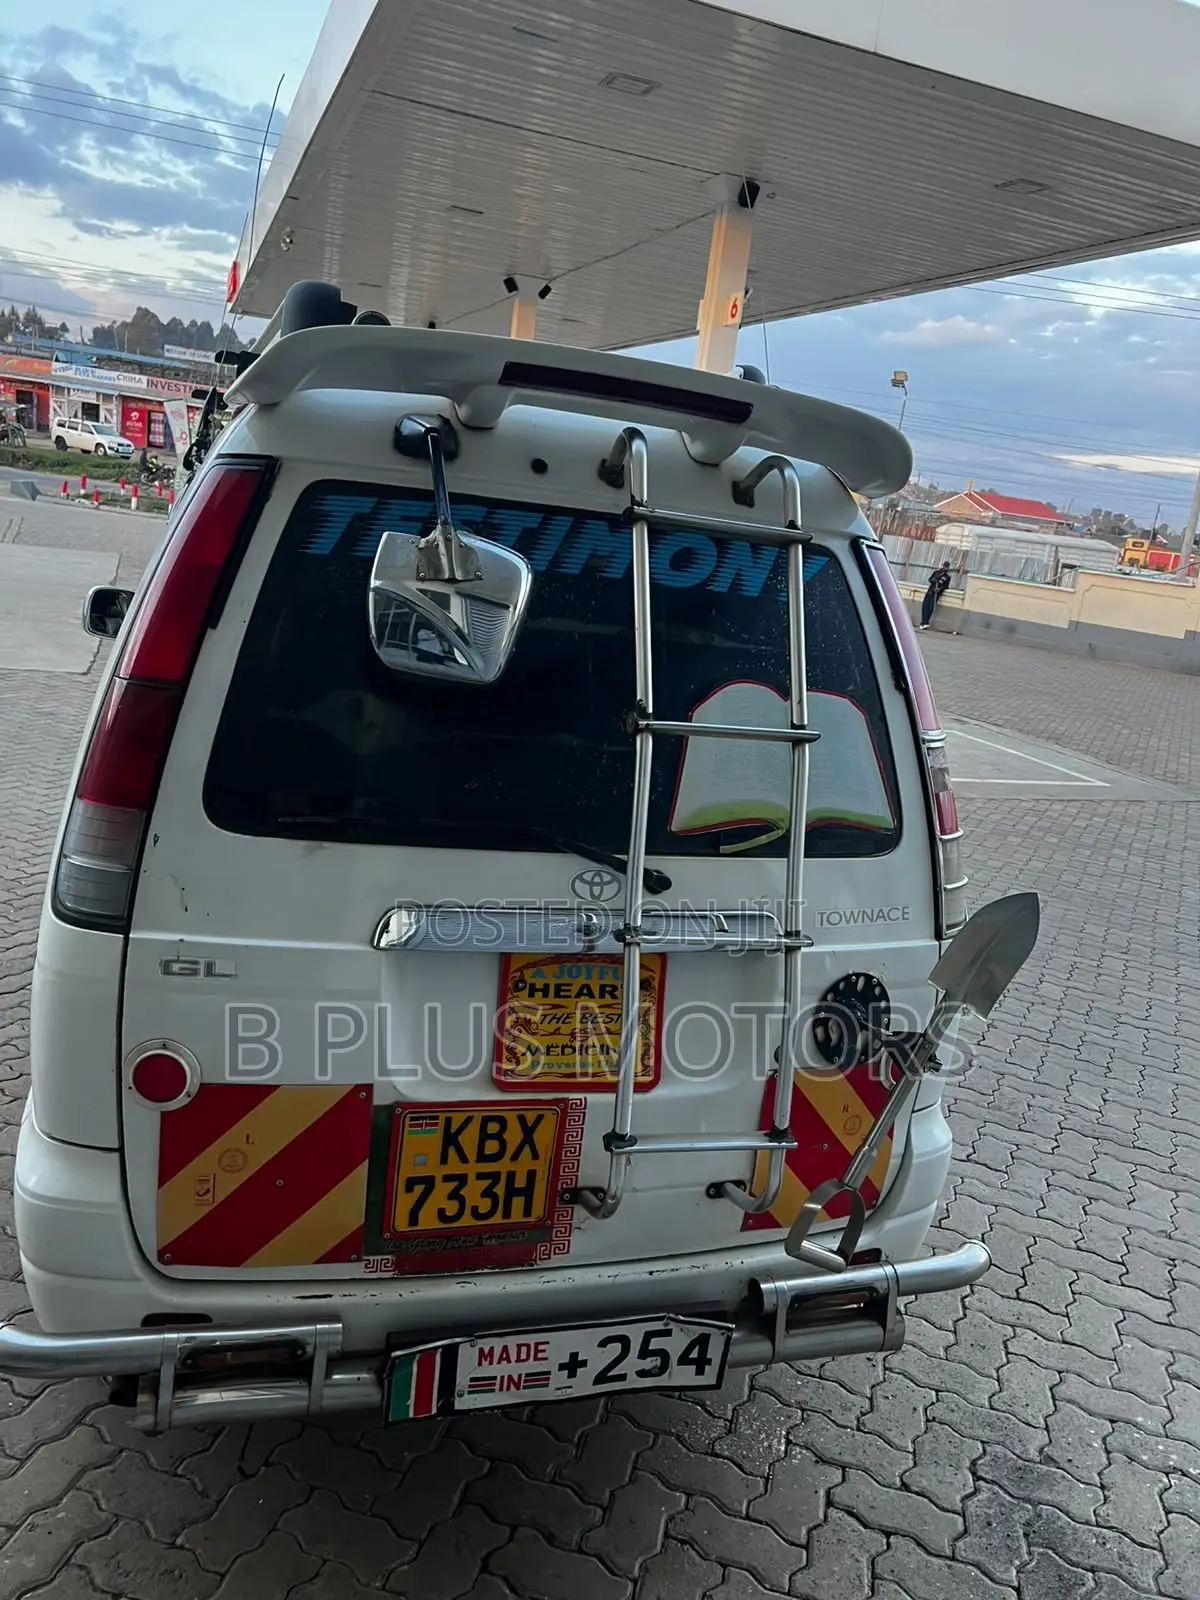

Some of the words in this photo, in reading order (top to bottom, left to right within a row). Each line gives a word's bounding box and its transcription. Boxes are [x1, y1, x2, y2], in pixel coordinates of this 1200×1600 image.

[731, 297, 738, 319] 6
[817, 906, 910, 927] TOWNACE
[161, 959, 238, 978] GL
[531, 967, 545, 979] A
[552, 964, 624, 981] JOYFU
[527, 983, 624, 1000] HEAR
[540, 1012, 577, 1025] THE
[521, 1044, 622, 1057] MEDICIN
[842, 1104, 849, 1113] R
[246, 1133, 255, 1145] L
[440, 1113, 545, 1166] KBX
[404, 1169, 537, 1227] 733H
[477, 1341, 550, 1367] MADE
[558, 1328, 713, 1387] +254
[499, 1373, 524, 1392] IN
